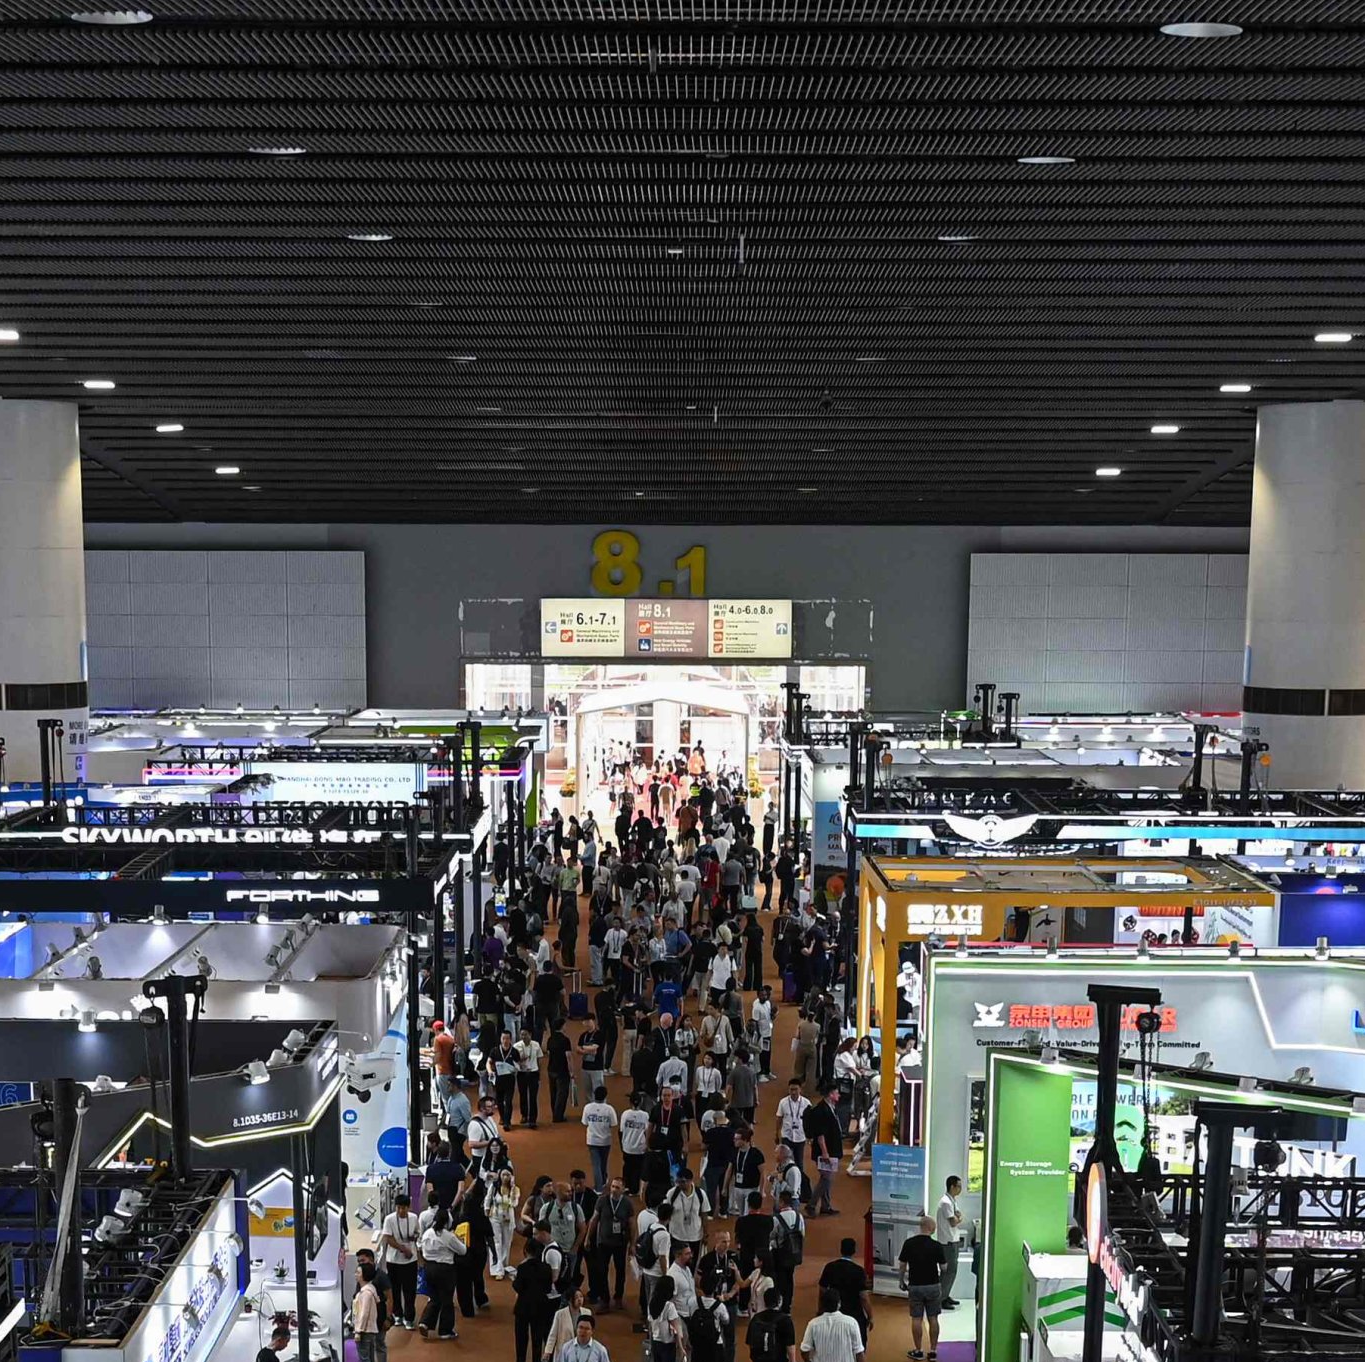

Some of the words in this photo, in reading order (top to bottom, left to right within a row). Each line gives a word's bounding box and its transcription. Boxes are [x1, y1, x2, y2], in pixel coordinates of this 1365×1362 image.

[590, 529, 706, 597] 8.1
[654, 604, 671, 617] 8.1
[576, 613, 616, 625] 6.1-7.1
[226, 890, 379, 902] FORTHING
[1009, 1018, 1050, 1028] ZONSEN
[1056, 1018, 1093, 1029] GROUP
[1056, 1040, 1100, 1049] Value-Drive
[1158, 1040, 1201, 1049] Committed
[1037, 1168, 1066, 1176] Provider
